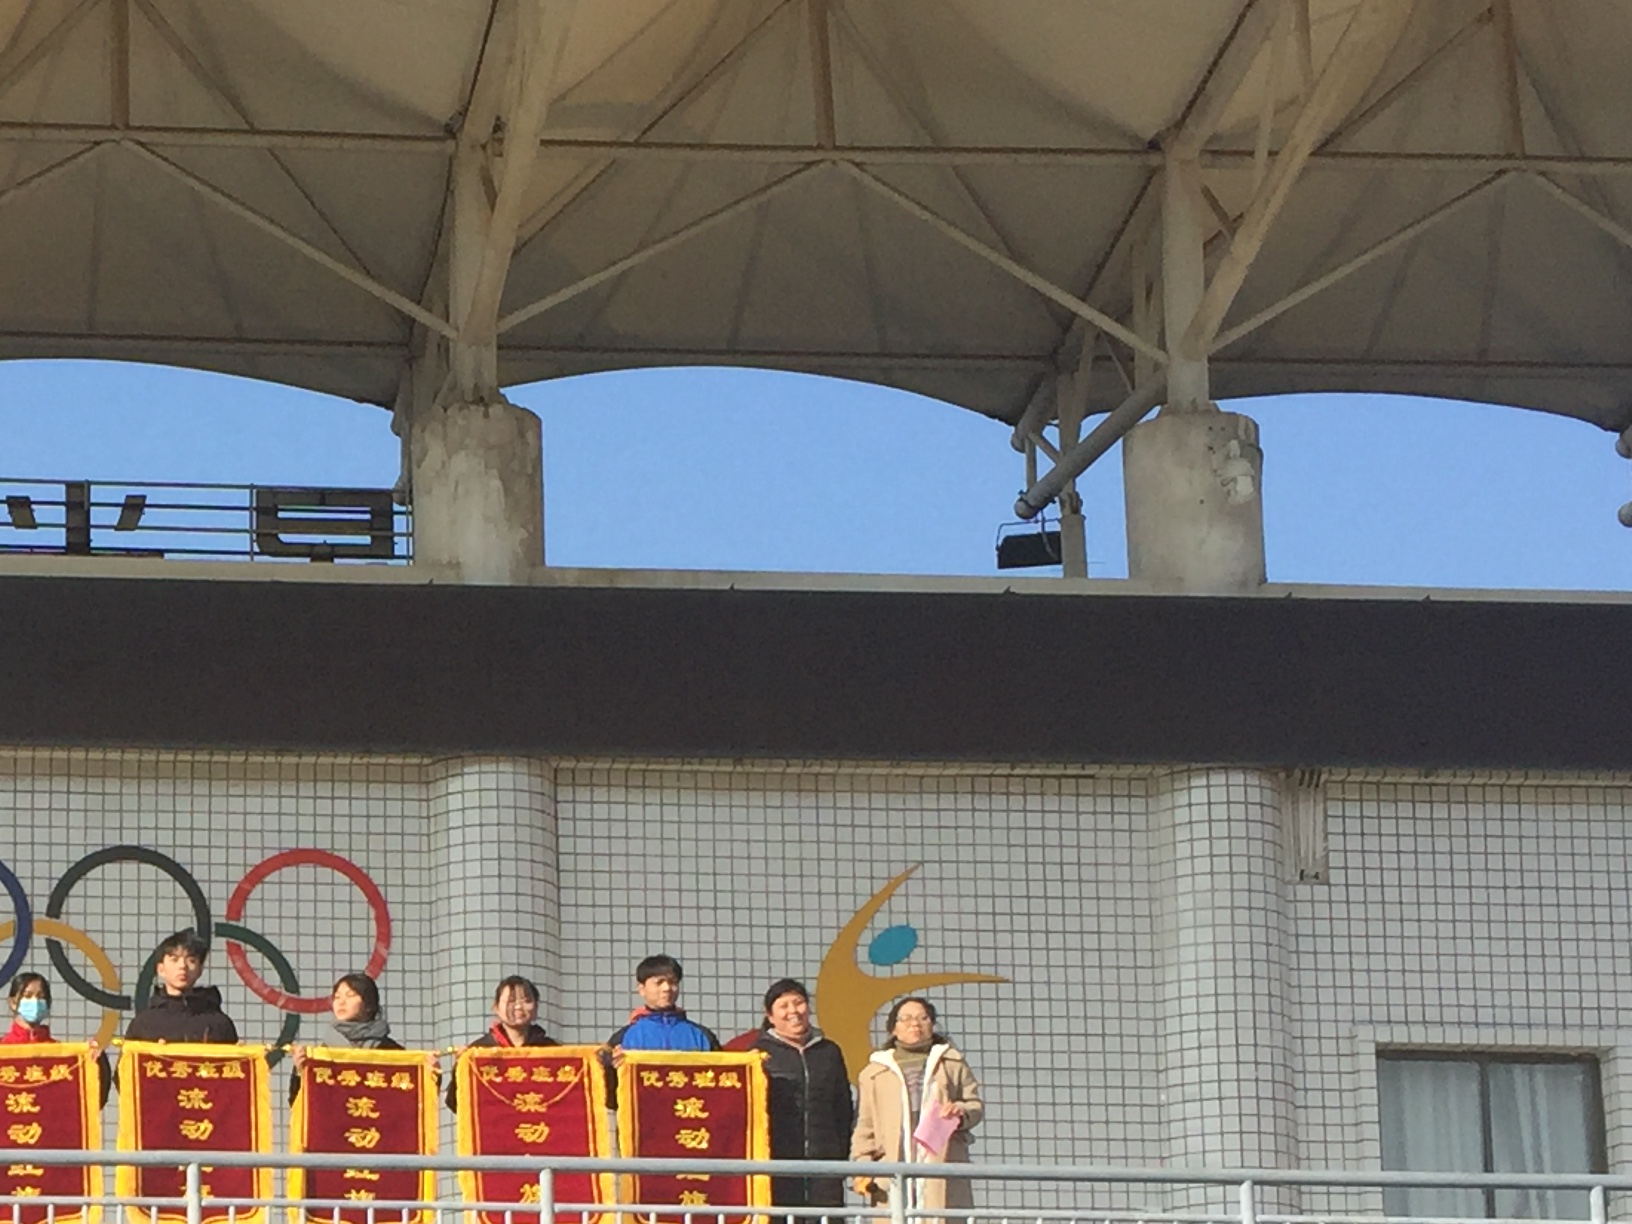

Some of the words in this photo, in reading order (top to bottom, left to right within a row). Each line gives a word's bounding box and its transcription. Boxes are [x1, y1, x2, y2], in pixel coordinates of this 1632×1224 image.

[142, 1060, 245, 1079] 优秀班级
[313, 1067, 415, 1090] 优秀班级
[479, 1064, 577, 1083] 优秀班级
[640, 1069, 742, 1089] 优秀班级
